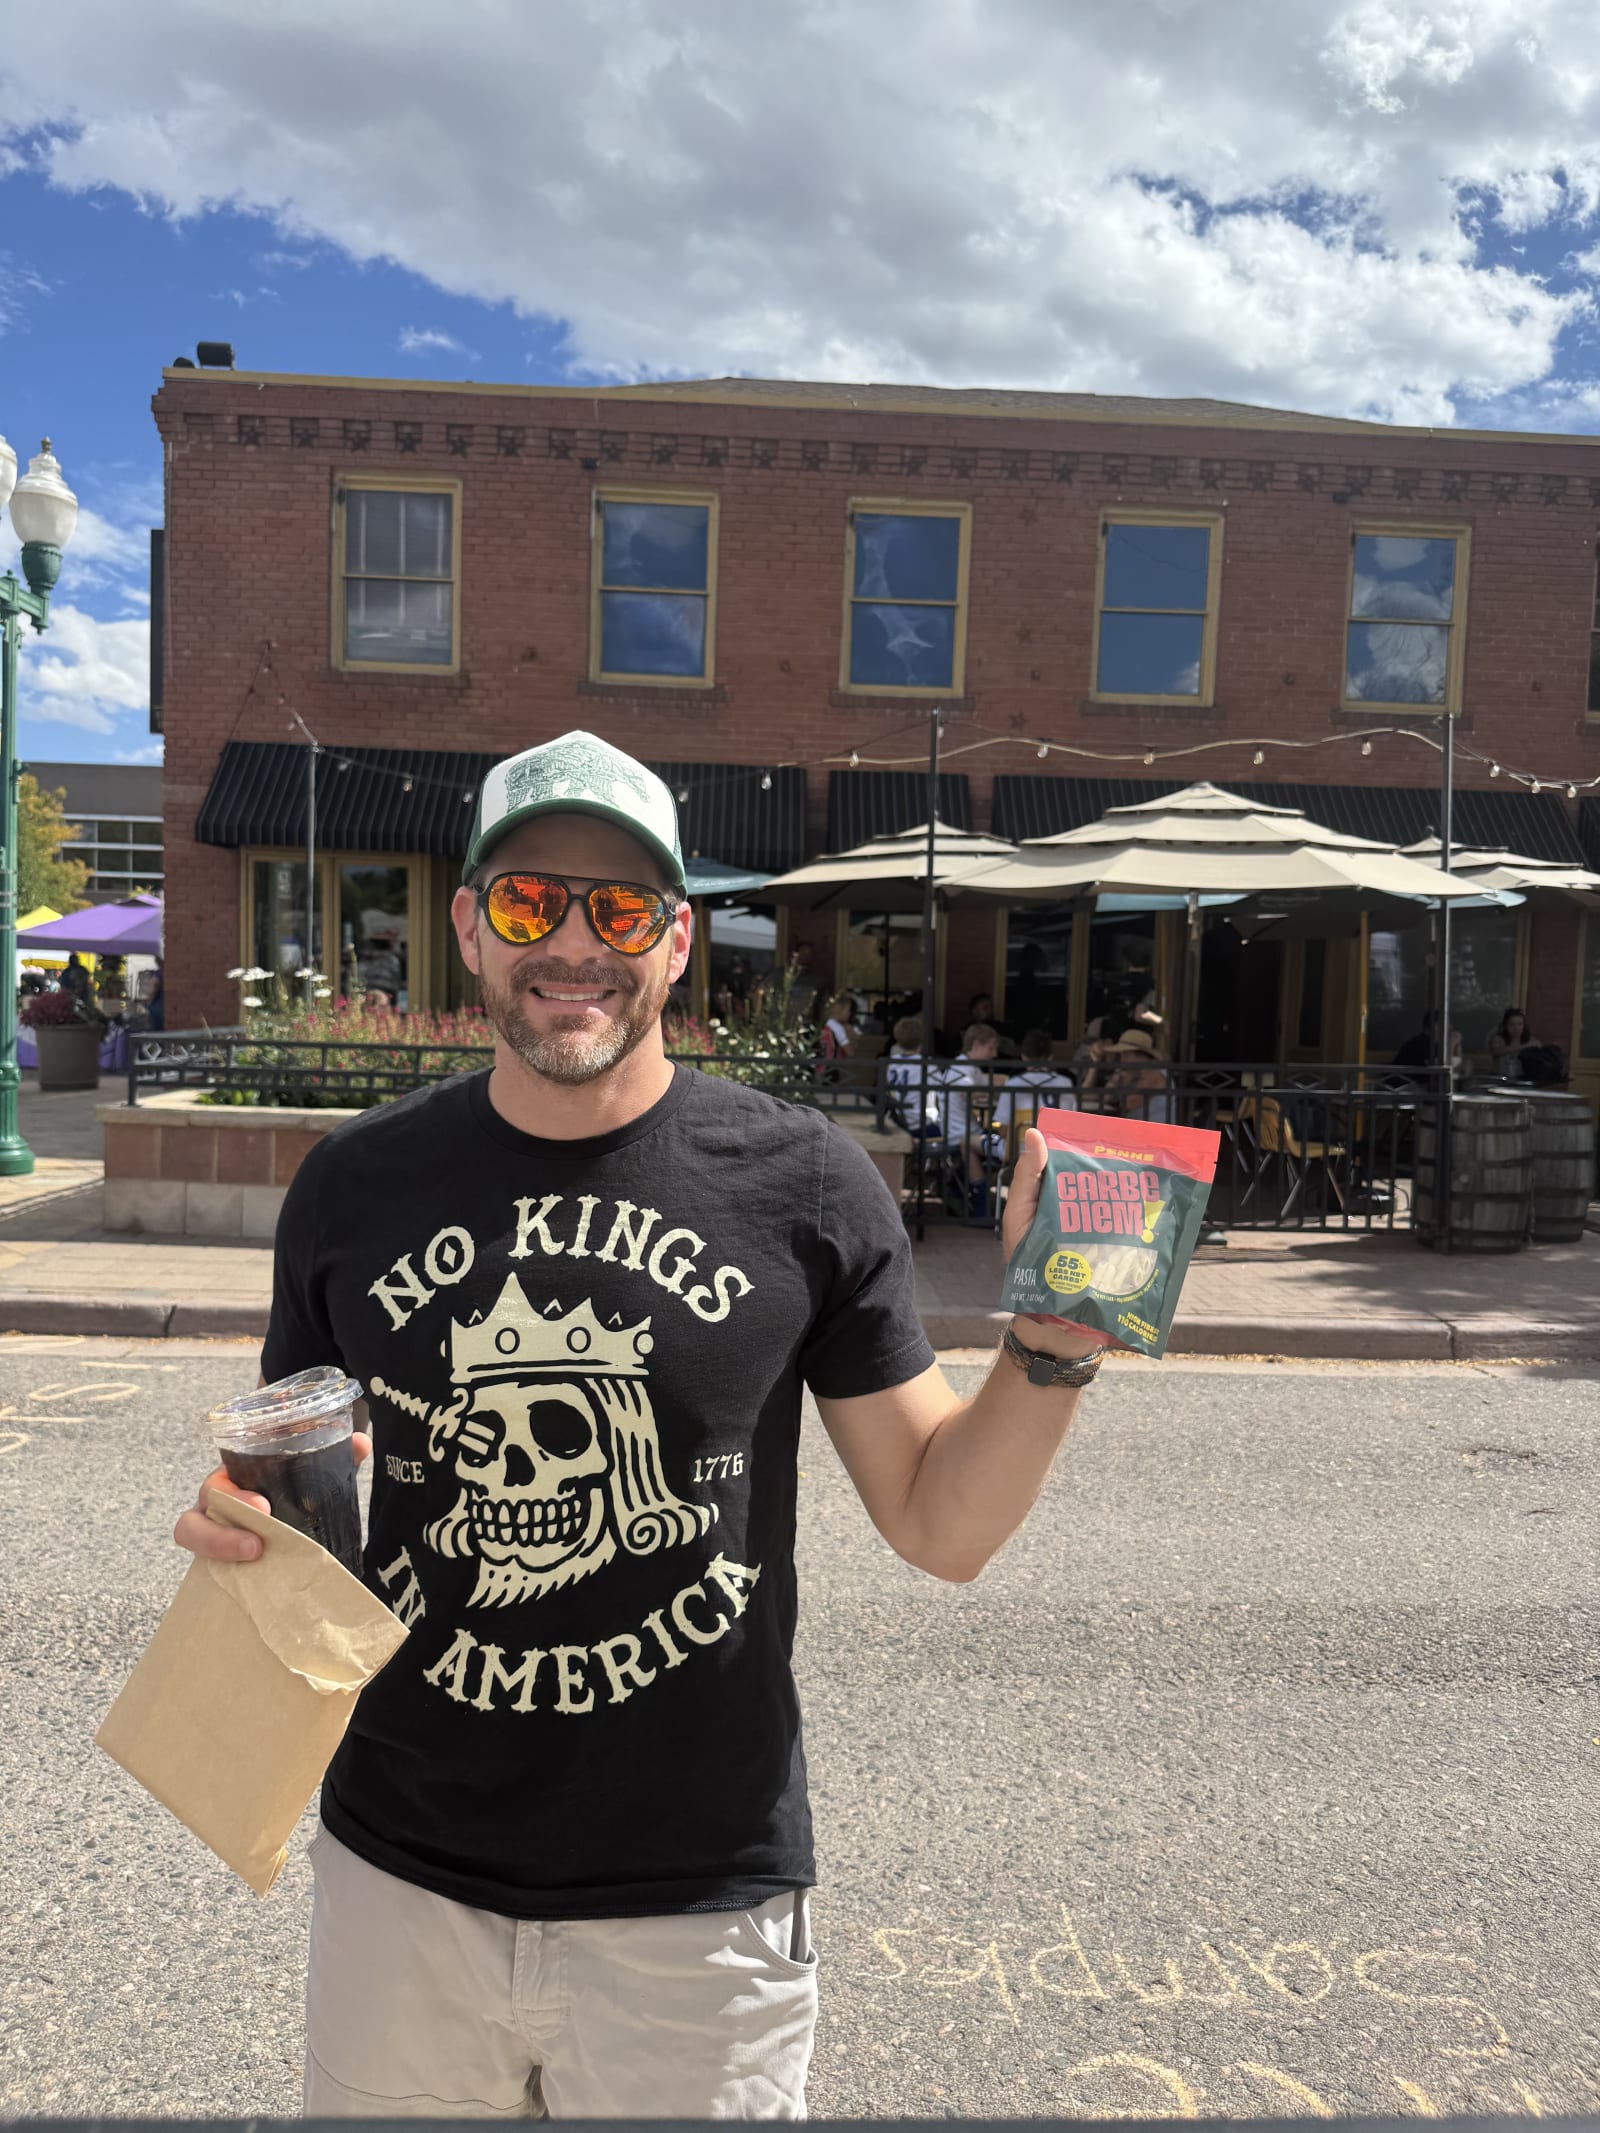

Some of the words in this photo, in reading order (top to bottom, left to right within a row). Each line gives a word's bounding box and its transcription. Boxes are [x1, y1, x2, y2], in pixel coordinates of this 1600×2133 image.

[1094, 1145, 1154, 1162] PENNE
[368, 1226, 475, 1331] NO
[508, 1194, 756, 1323] KINGS
[1056, 1255, 1084, 1270] 55%
[1013, 1267, 1037, 1286] PASTA
[1069, 1271, 1087, 1279] NET
[1117, 1313, 1129, 1327] 110
[1126, 1311, 1141, 1326] HIGH
[386, 1454, 425, 1484] SINCE
[692, 1451, 744, 1483] 1776
[376, 1545, 426, 1629] IN
[423, 1552, 762, 1715] AMERICA
